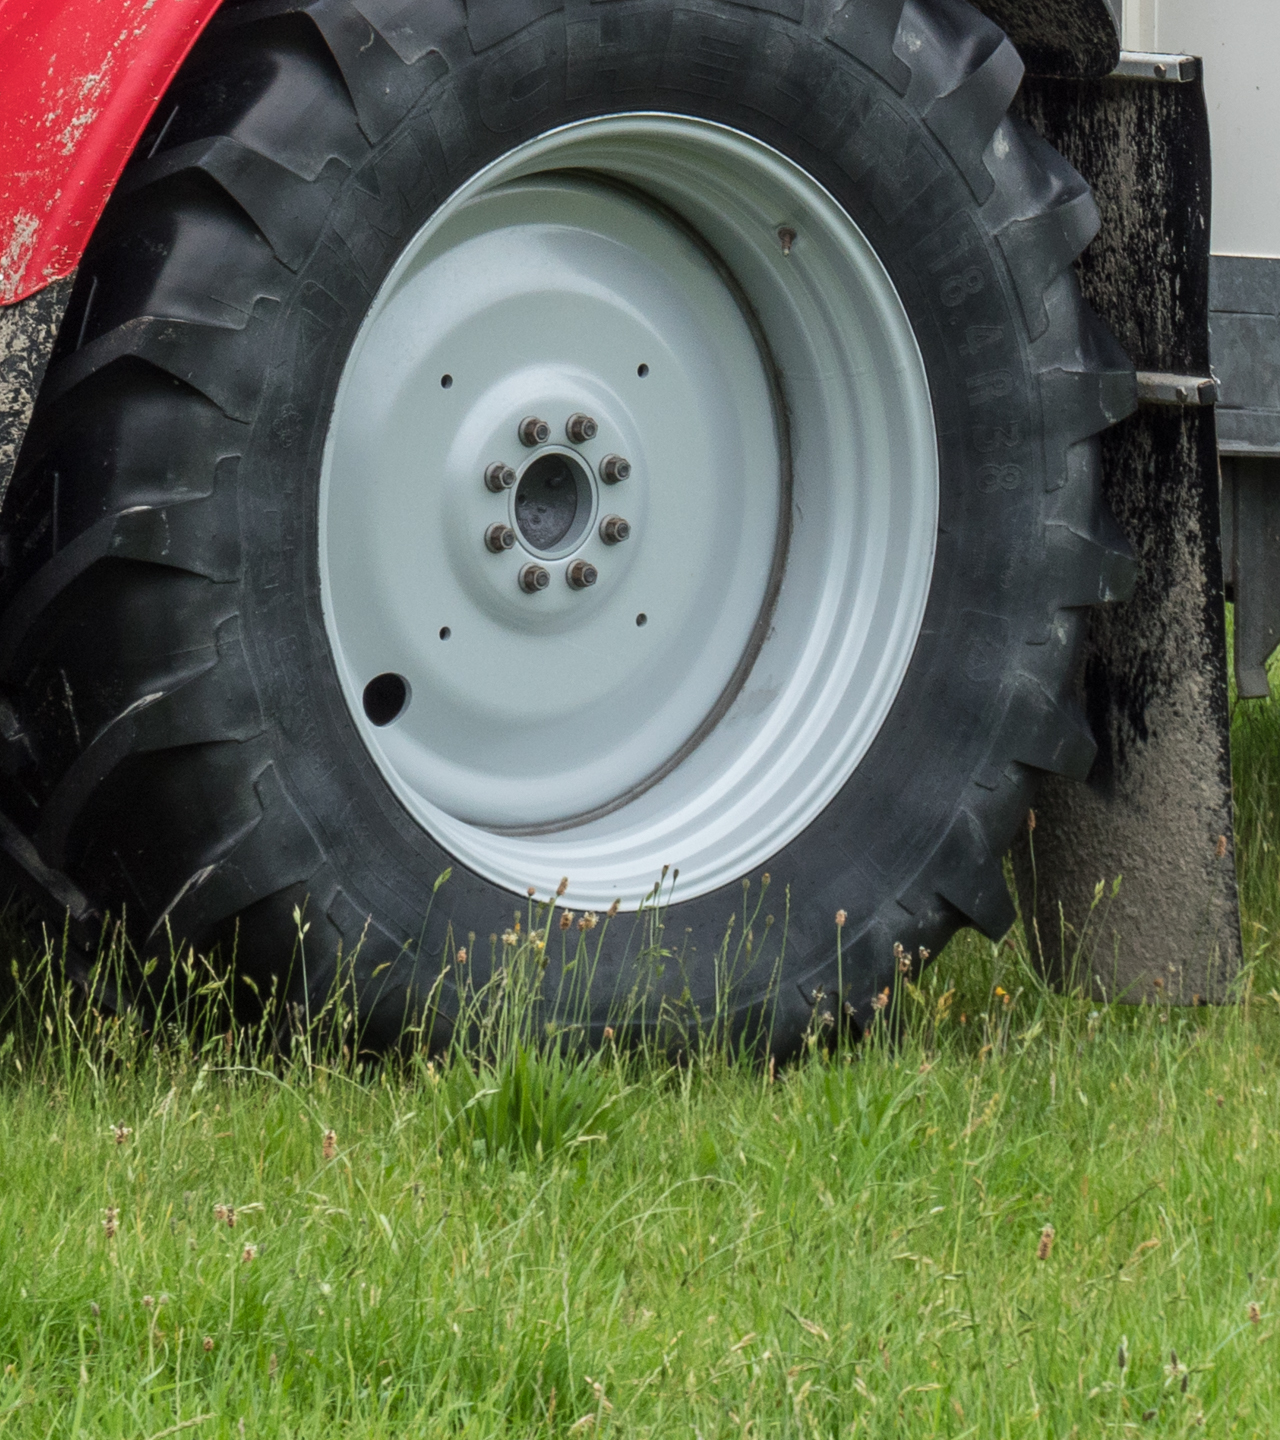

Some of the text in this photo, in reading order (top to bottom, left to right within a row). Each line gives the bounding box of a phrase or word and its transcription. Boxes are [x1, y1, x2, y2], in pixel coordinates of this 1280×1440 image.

[322, 7, 940, 272] MICHELIN
[965, 370, 1014, 407] R
[972, 418, 1026, 494] 38
